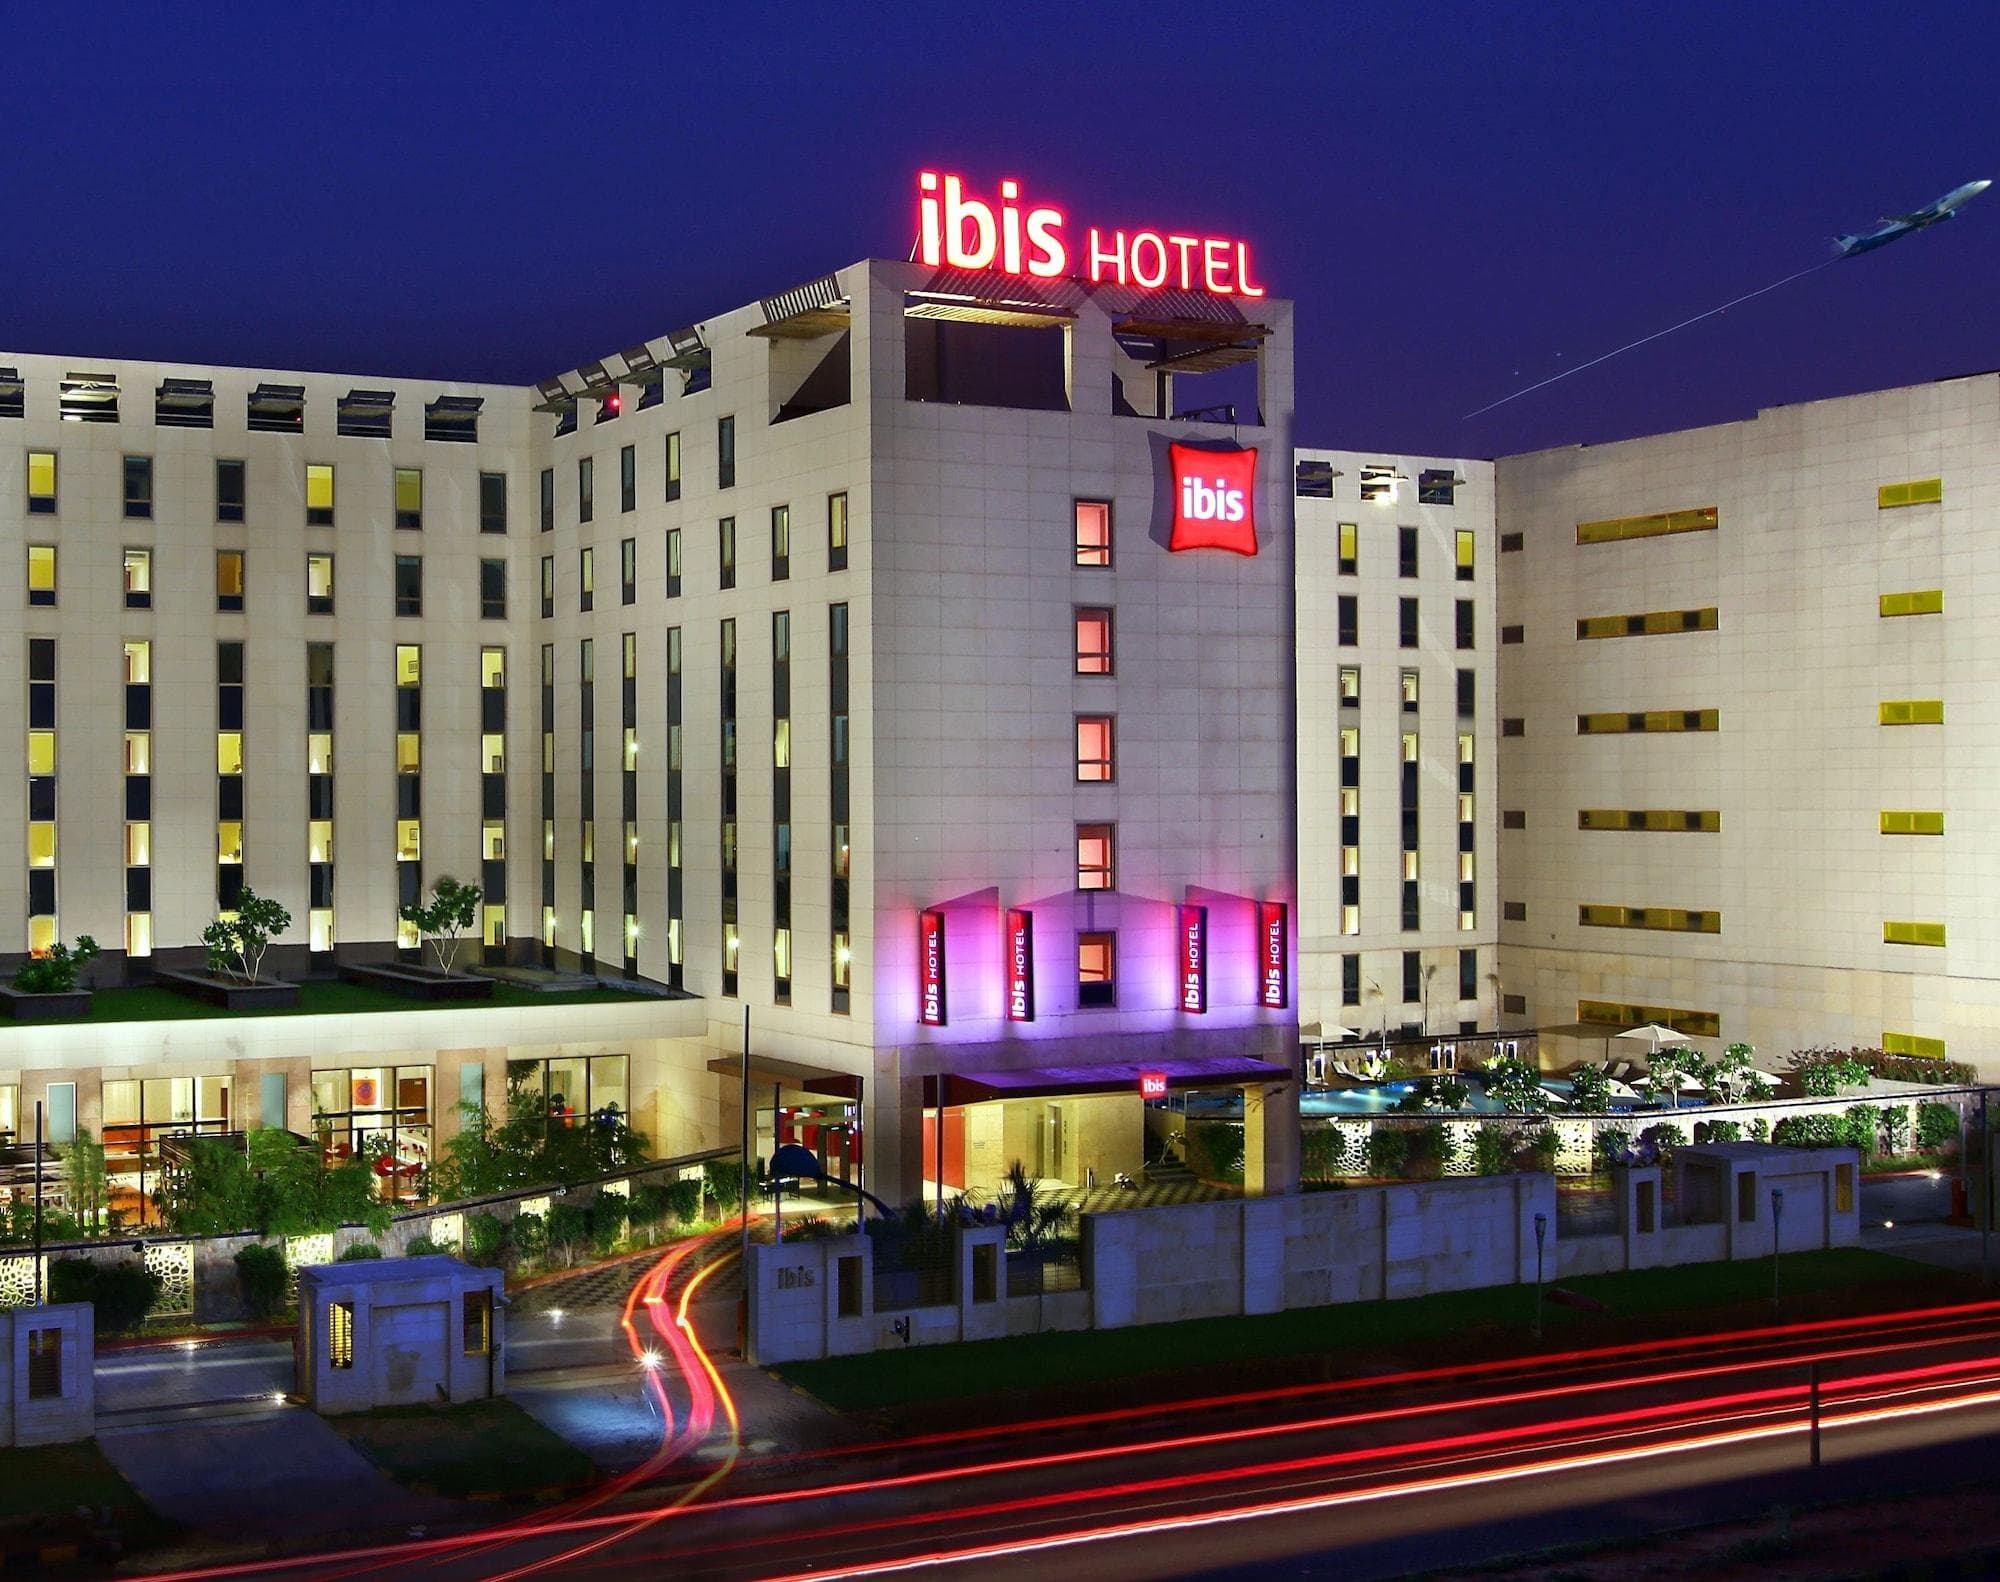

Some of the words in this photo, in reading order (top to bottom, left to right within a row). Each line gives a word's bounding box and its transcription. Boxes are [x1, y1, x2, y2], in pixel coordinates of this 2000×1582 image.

[919, 171, 1067, 278] ibis
[1090, 227, 1265, 297] HOTEL
[1182, 476, 1246, 522] ibis
[928, 930, 938, 979] HOTEL
[1015, 928, 1025, 976] HOTEL
[1188, 922, 1199, 969] HOTEL
[1269, 919, 1281, 965] HOTEL
[925, 983, 939, 1021] ibis
[1011, 980, 1026, 1018] ibis
[1184, 973, 1200, 1009] ibis
[1265, 968, 1281, 1005] ibis
[1143, 1078, 1166, 1093] ibis
[777, 1265, 816, 1290] ibis
